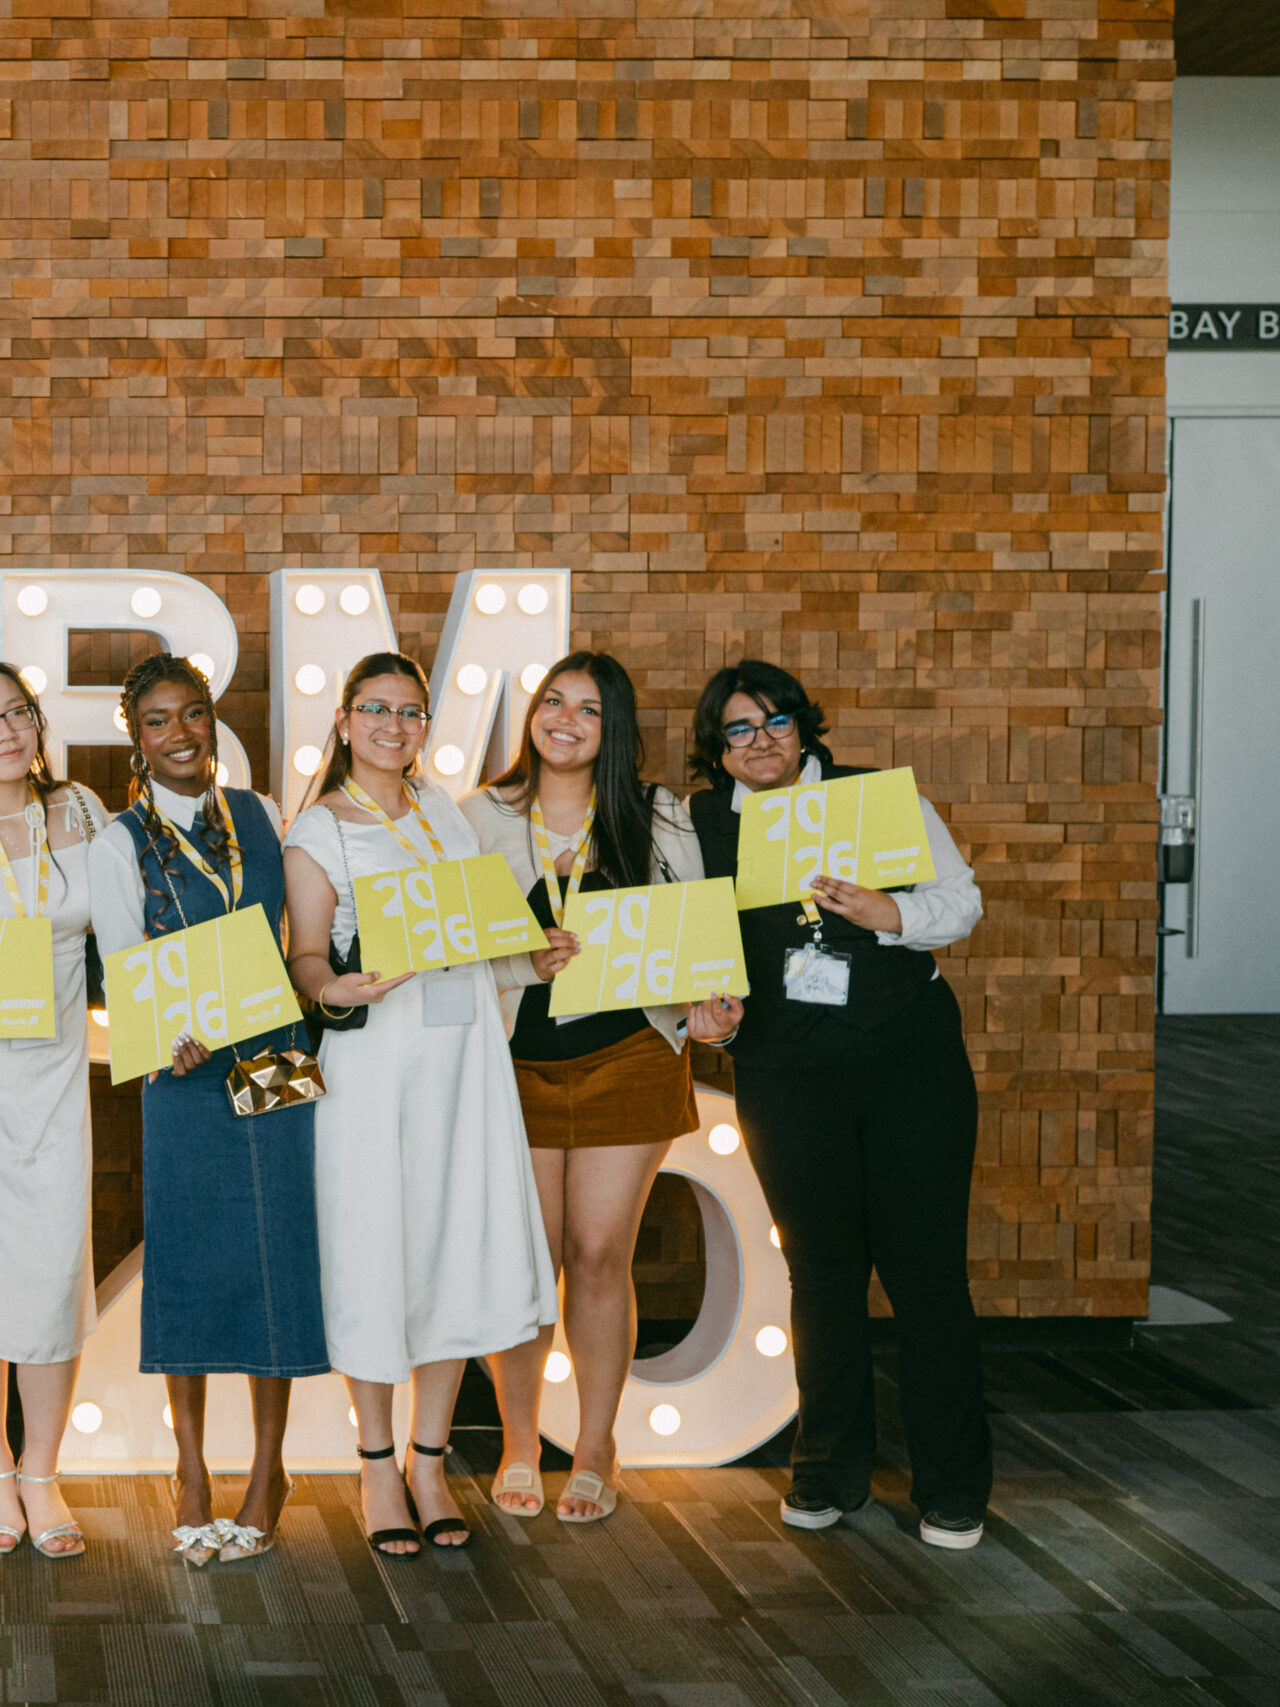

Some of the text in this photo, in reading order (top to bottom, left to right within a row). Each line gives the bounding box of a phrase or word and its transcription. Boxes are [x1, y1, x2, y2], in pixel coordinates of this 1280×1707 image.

[1169, 310, 1280, 340] BAY B
[760, 789, 826, 842] 20
[792, 840, 857, 891] 26
[371, 871, 437, 919] 20
[584, 893, 650, 945] 20
[412, 913, 478, 962] 26
[123, 940, 189, 1003] 20
[611, 949, 674, 1000] 26
